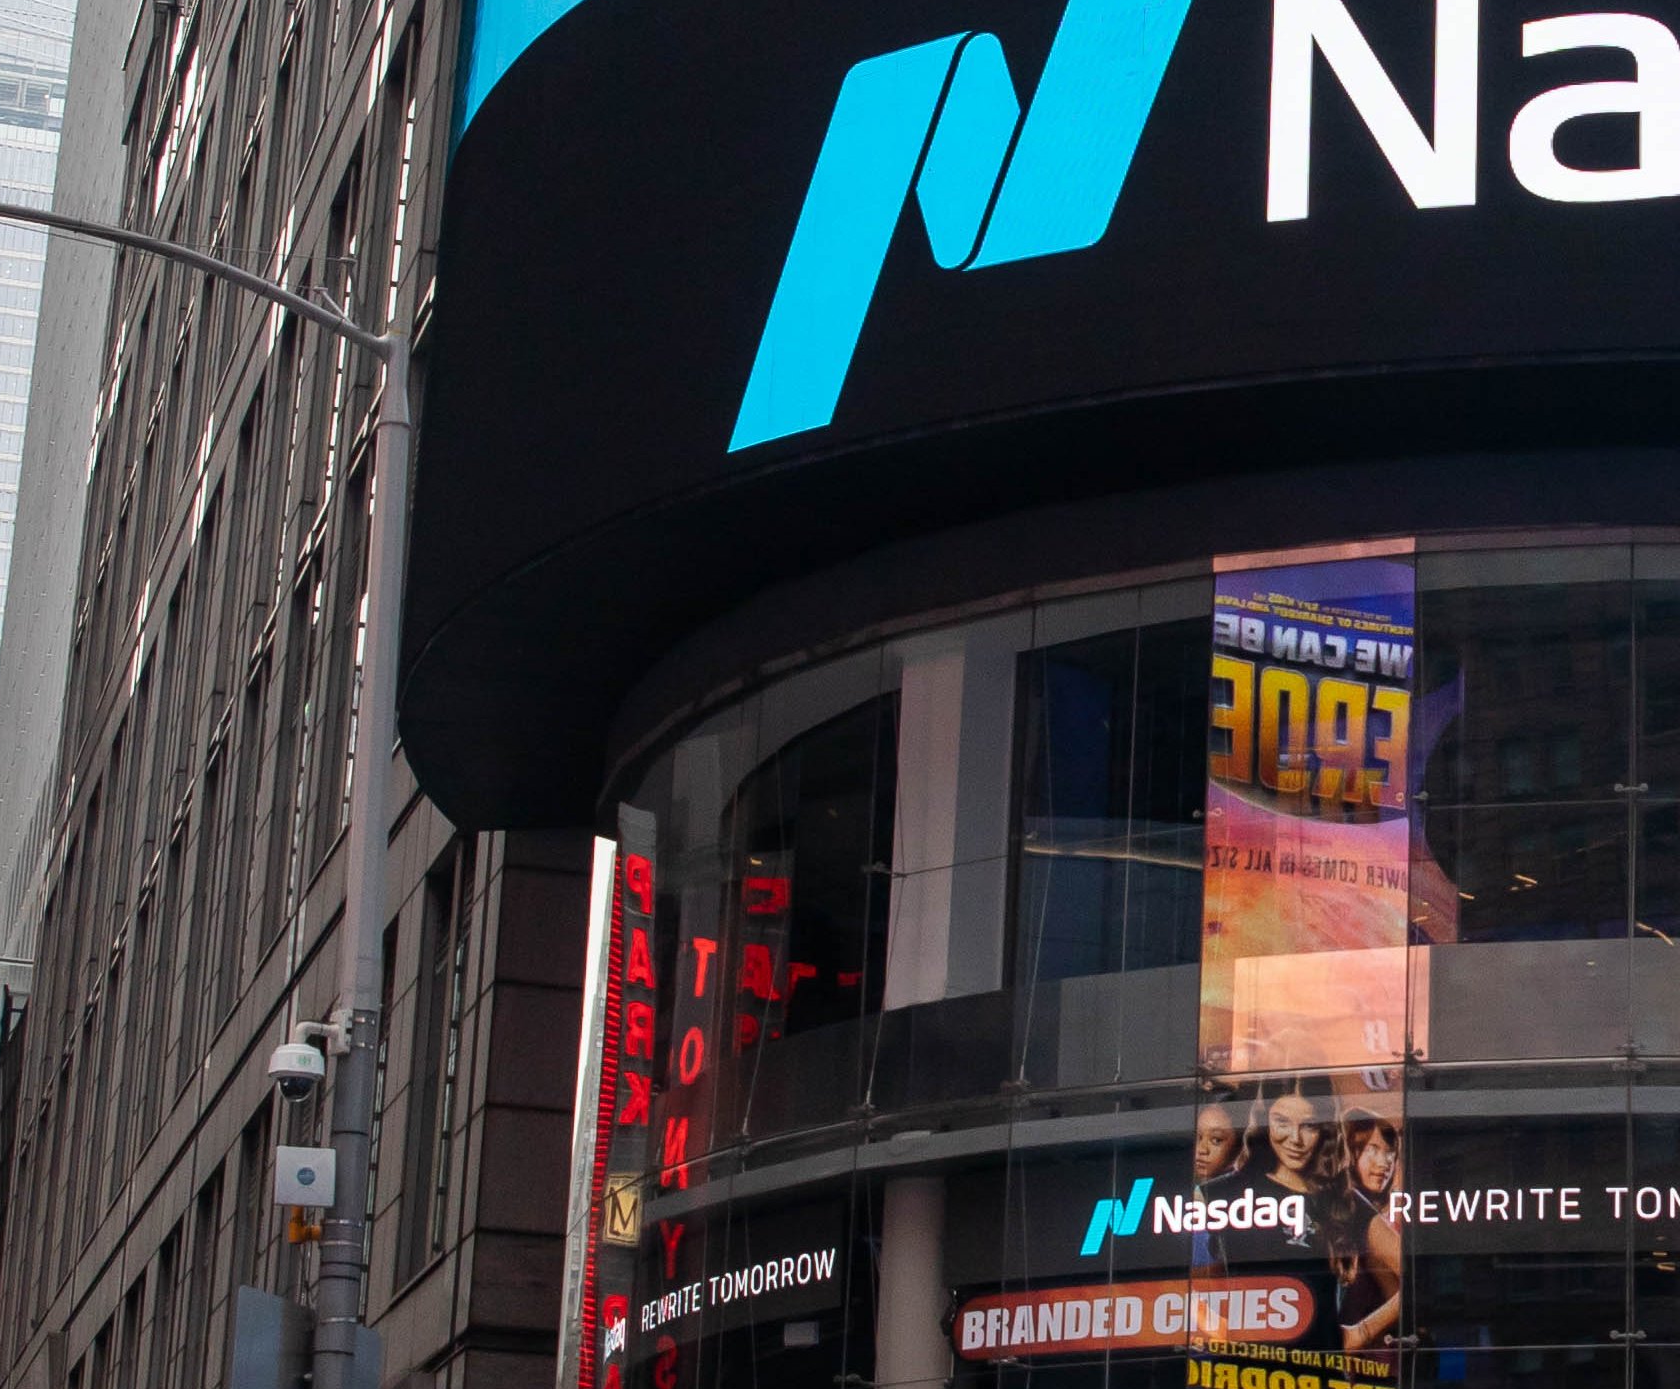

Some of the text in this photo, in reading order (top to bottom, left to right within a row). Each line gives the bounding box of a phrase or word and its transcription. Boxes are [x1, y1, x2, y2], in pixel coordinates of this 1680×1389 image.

[1153, 1188, 1305, 1236] Nasdaq
[1389, 1187, 1581, 1223] REWRITE
[641, 1247, 837, 1333] REWRITE TOMORROW
[961, 1287, 1301, 1351] BRANDED CITIES
